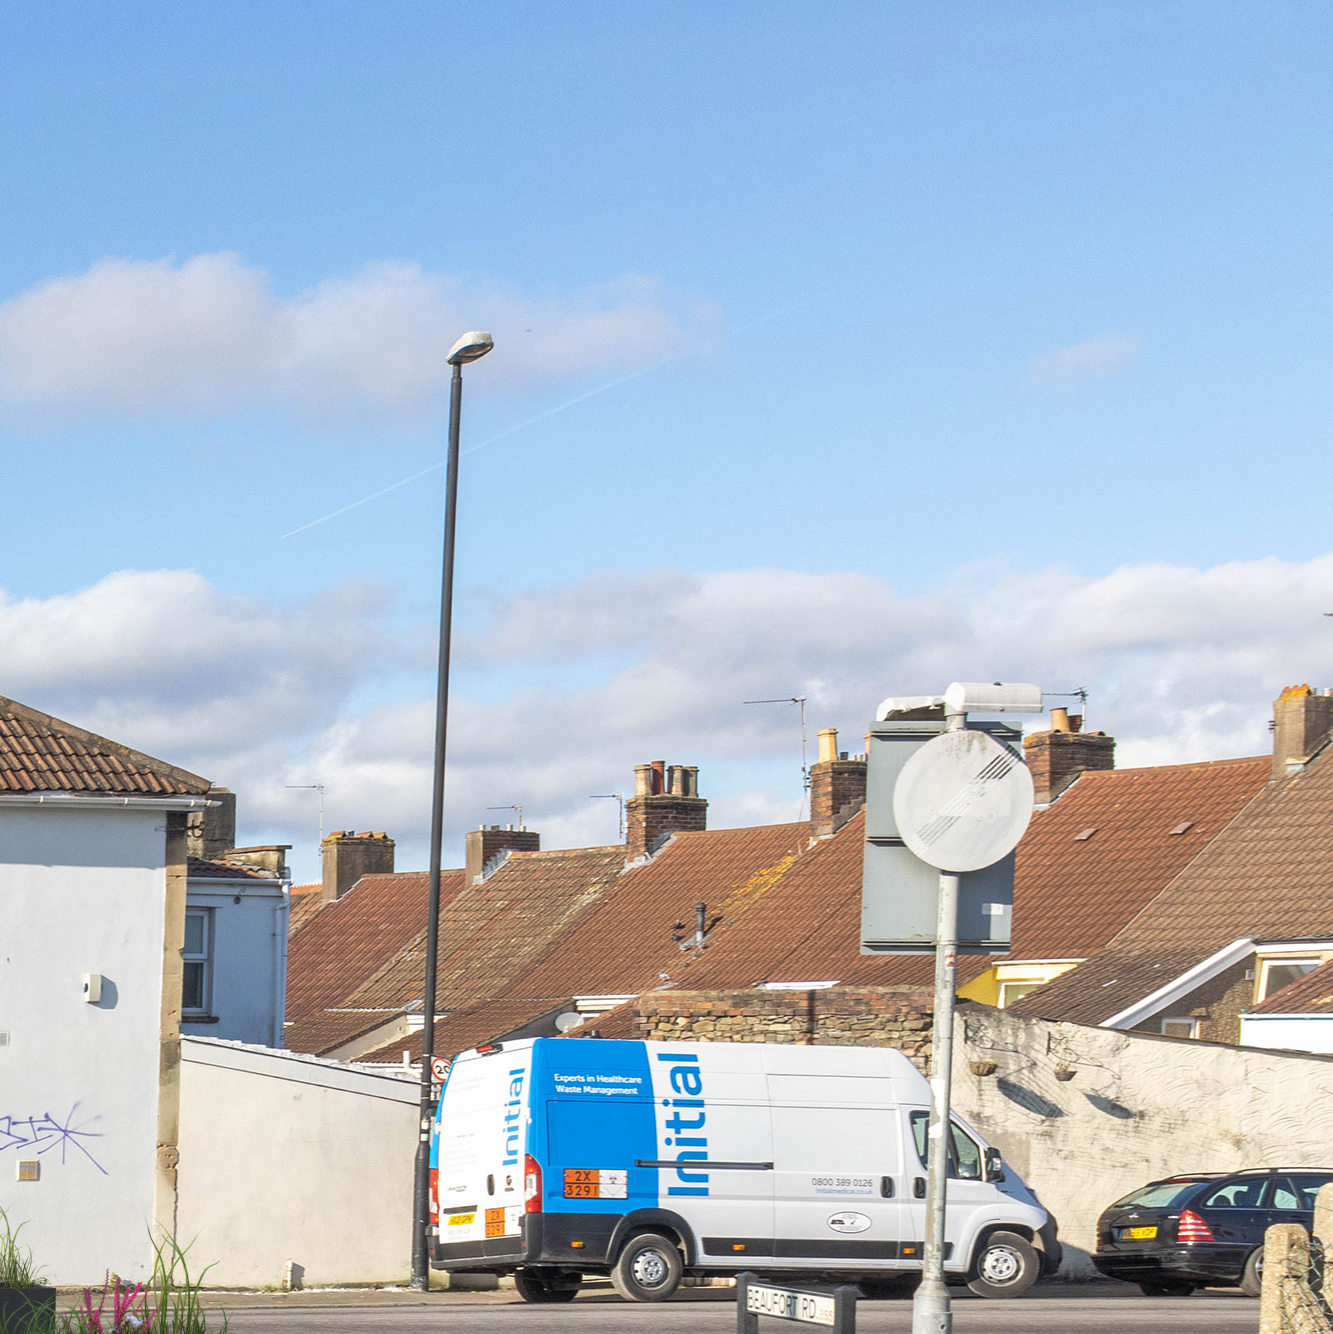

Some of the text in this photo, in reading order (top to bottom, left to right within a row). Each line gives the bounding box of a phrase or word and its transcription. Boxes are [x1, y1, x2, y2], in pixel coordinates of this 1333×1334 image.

[554, 1073, 642, 1084] Experts in Healthcare
[555, 1085, 638, 1095] Waste Management
[502, 1068, 525, 1166] Initial
[656, 1053, 709, 1197] Initial
[574, 1171, 591, 1181] 2X
[811, 1177, 873, 1188] 0800 389 0126
[566, 1185, 598, 1196] 3291
[748, 1288, 799, 1317] BEAUFORT
